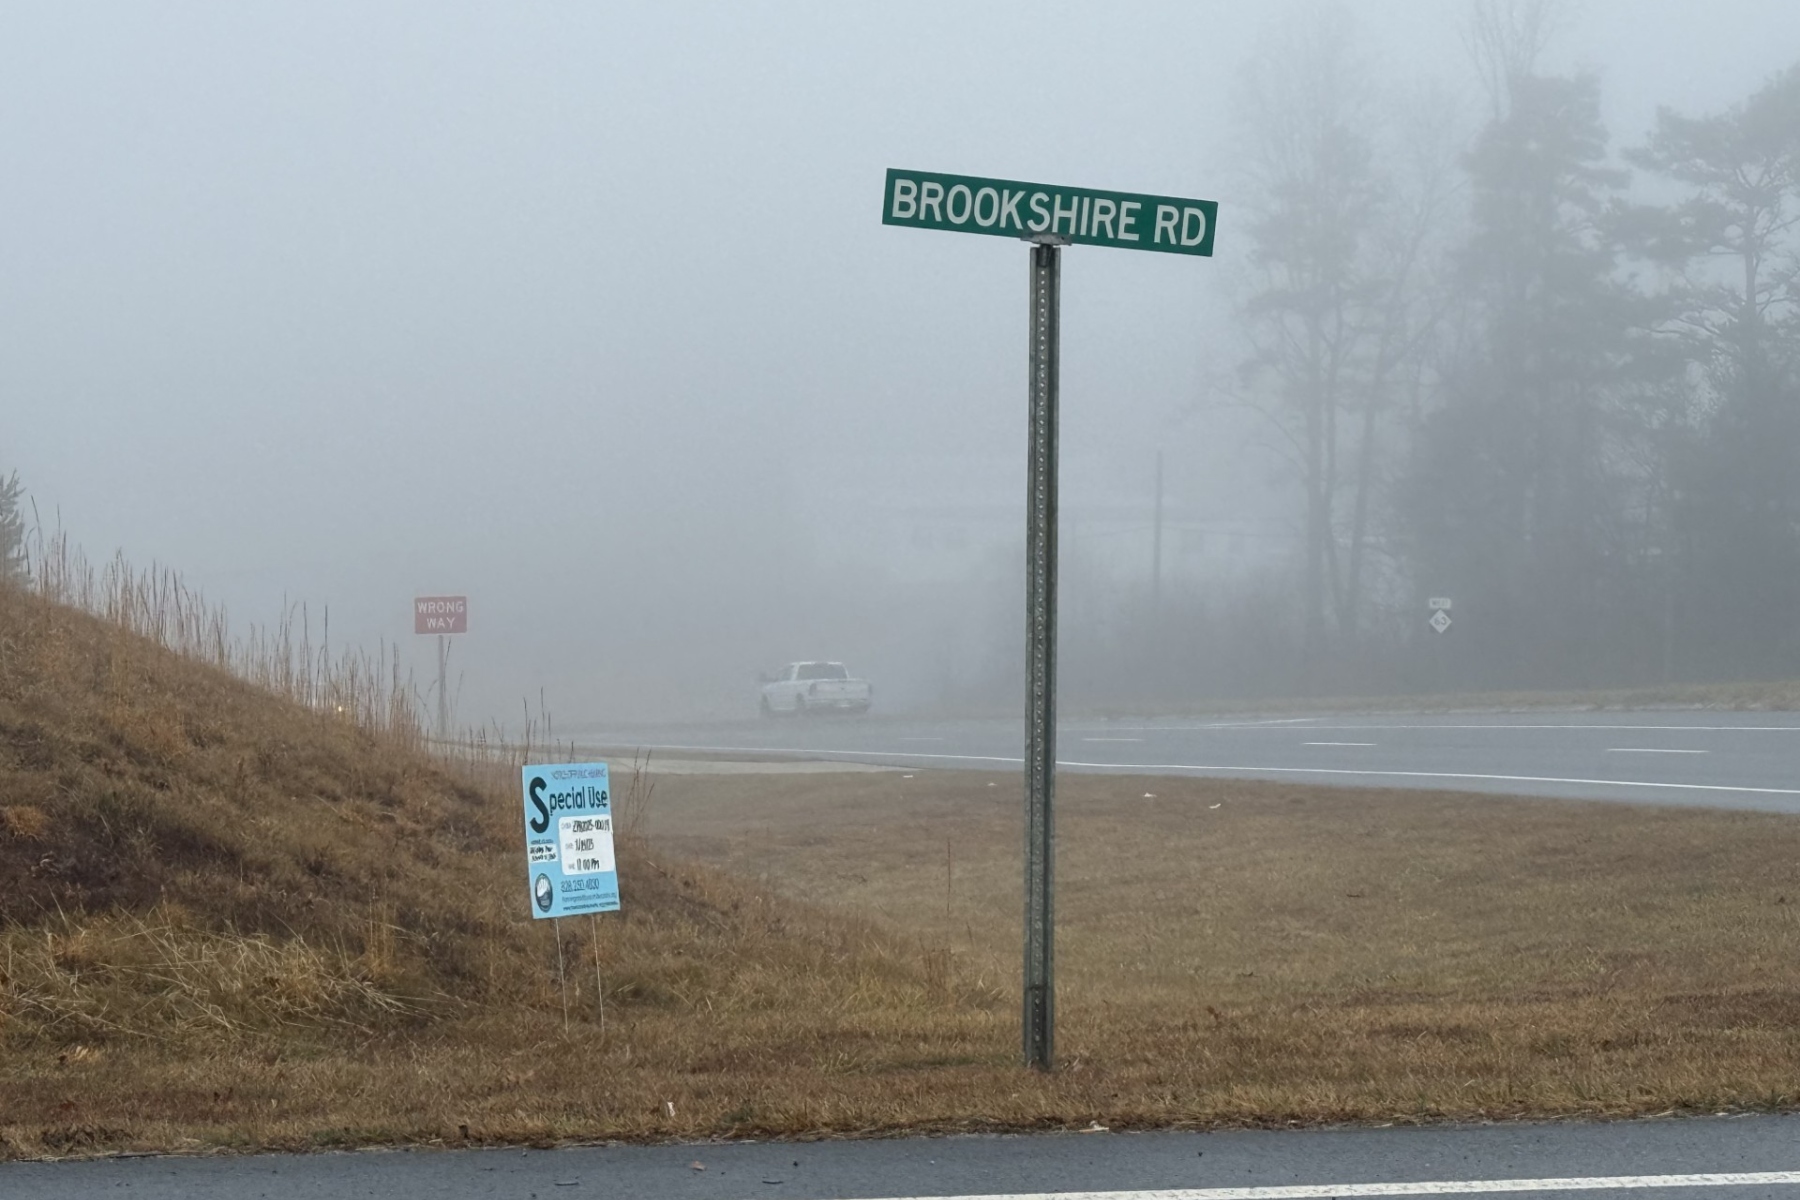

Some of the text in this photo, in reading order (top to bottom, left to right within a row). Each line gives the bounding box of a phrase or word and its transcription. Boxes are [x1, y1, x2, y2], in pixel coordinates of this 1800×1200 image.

[891, 178, 1207, 247] BROOKSHIRE RD
[417, 601, 464, 614] WRONG
[426, 616, 456, 630] WAY
[529, 776, 608, 834] Special Use
